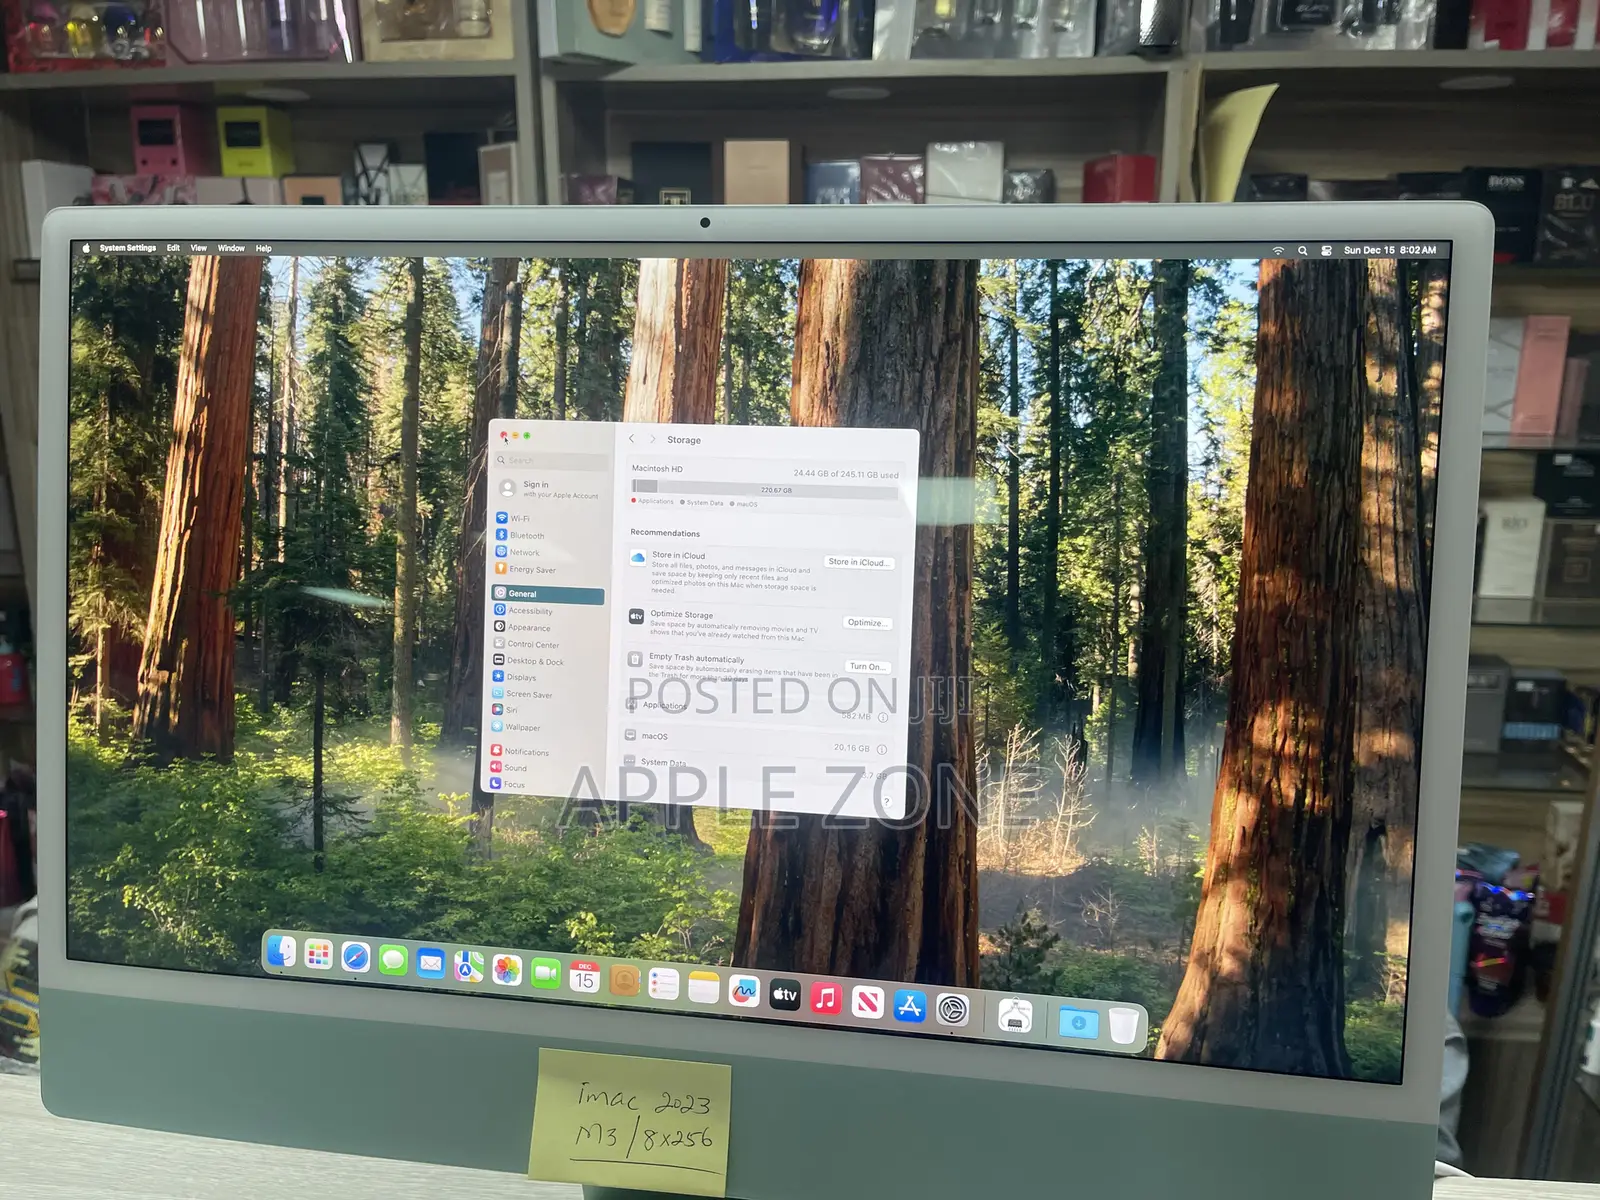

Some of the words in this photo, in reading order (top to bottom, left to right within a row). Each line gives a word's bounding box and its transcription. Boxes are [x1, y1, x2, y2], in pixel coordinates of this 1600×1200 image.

[100, 244, 125, 252] System
[127, 244, 156, 253] Settings
[167, 244, 180, 252] Edit
[191, 244, 207, 252] View
[218, 244, 245, 252] Window
[256, 244, 272, 253] Help
[668, 436, 701, 446] Storage
[509, 457, 533, 465] Search
[524, 481, 538, 489] Sign
[554, 492, 571, 500] Apple
[511, 532, 544, 540] Bluetooth
[631, 529, 700, 537] Recommendations
[510, 549, 540, 557] Network
[682, 552, 705, 560] iCloud
[510, 566, 534, 574] Energy
[536, 566, 556, 574] Saver
[509, 590, 537, 598] General
[509, 607, 553, 616] Accessibility
[651, 610, 682, 618] Optimize
[685, 612, 713, 620] Storage
[508, 624, 551, 632] Appearance
[697, 622, 738, 630] automatically
[733, 632, 759, 640] watched
[508, 640, 534, 648] Control
[536, 641, 559, 649] Center
[508, 657, 537, 665] Desktop
[650, 653, 672, 661] Empty
[696, 655, 744, 664] automatically
[696, 665, 738, 674] automatically
[507, 674, 536, 682] Displays
[643, 702, 687, 710] Applications
[506, 724, 540, 732] Wallpaper
[505, 748, 549, 756] Notifications
[641, 758, 668, 766] System
[505, 764, 527, 772] Sound
[575, 973, 594, 988] 15
[655, 1092, 710, 1114] 2023
